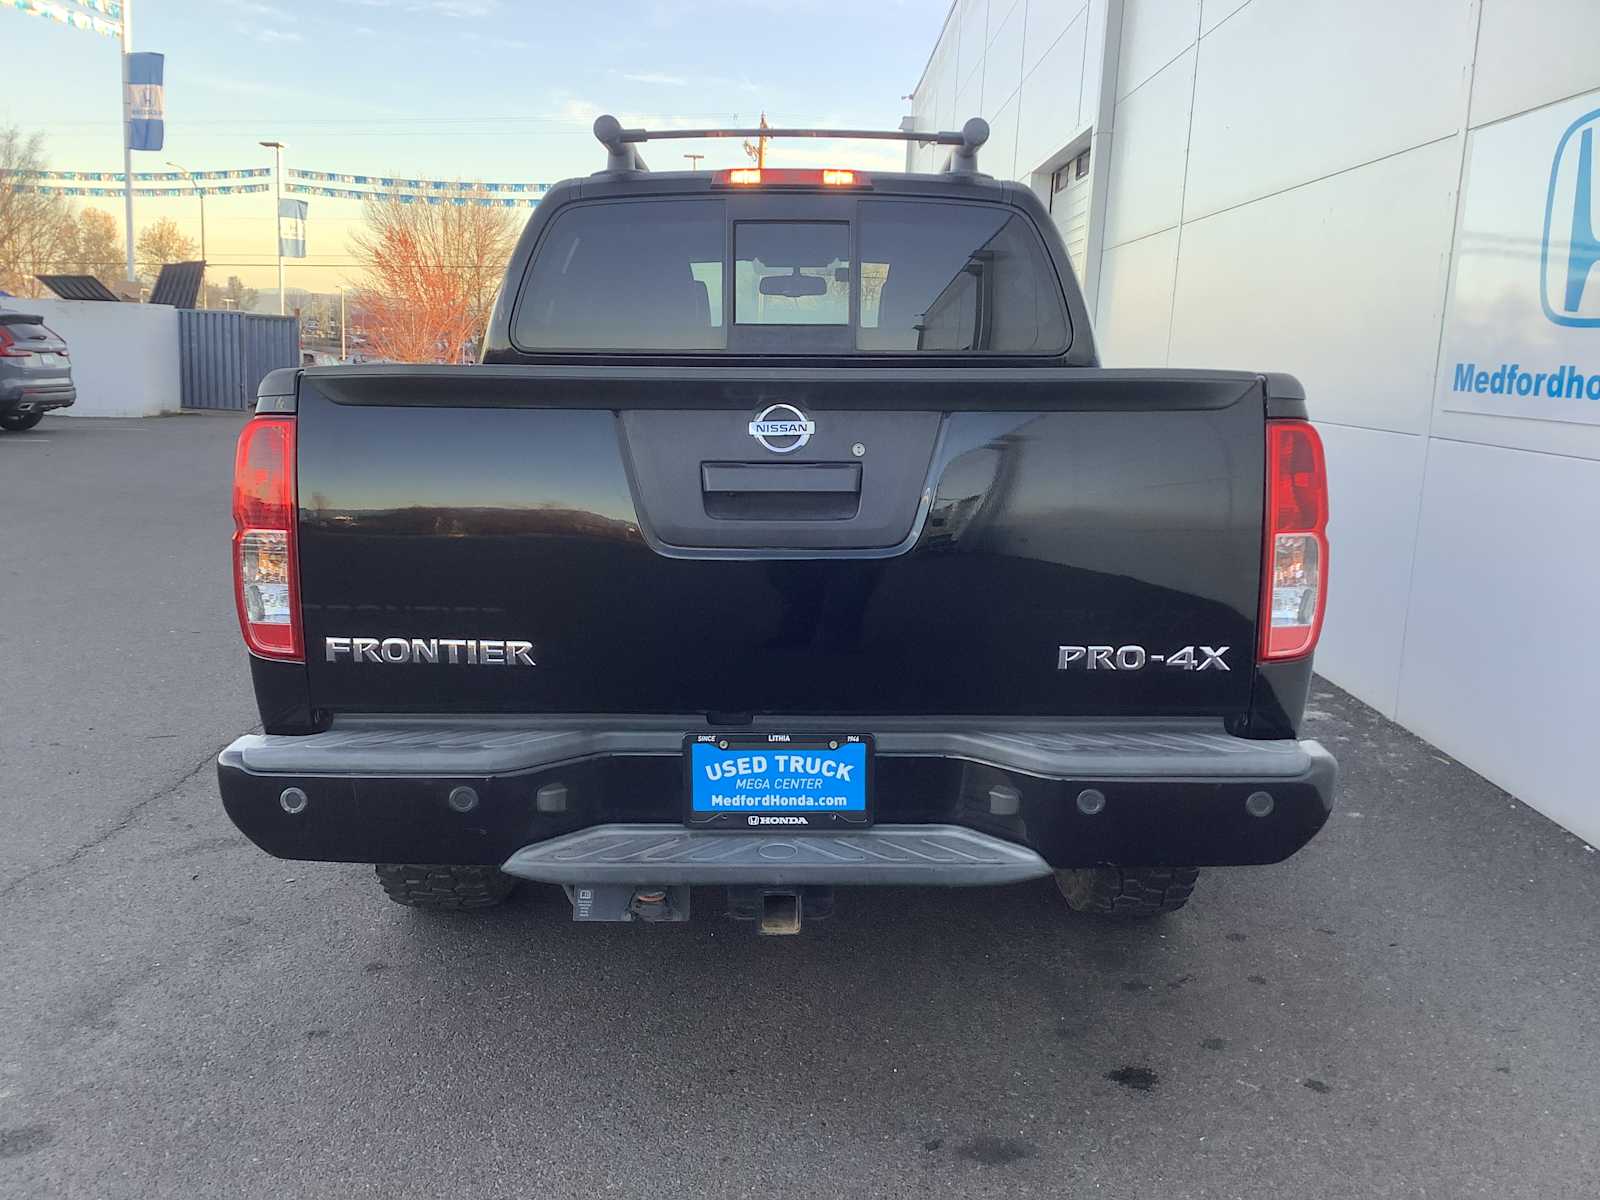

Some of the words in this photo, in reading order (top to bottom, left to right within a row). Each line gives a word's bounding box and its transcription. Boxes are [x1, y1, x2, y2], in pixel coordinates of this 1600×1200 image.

[1453, 363, 1600, 400] Medfordho
[756, 424, 807, 433] NISSAN
[325, 636, 536, 666] FRONTIER
[1057, 645, 1231, 671] PRO-4X
[768, 734, 790, 742] LITHIA
[705, 755, 768, 781] USED
[774, 755, 855, 782] TRUCK
[735, 778, 770, 790] MEGA
[774, 778, 823, 790] CENTER
[711, 794, 847, 807] MedfordHonda.com
[760, 816, 809, 825] HONDA
